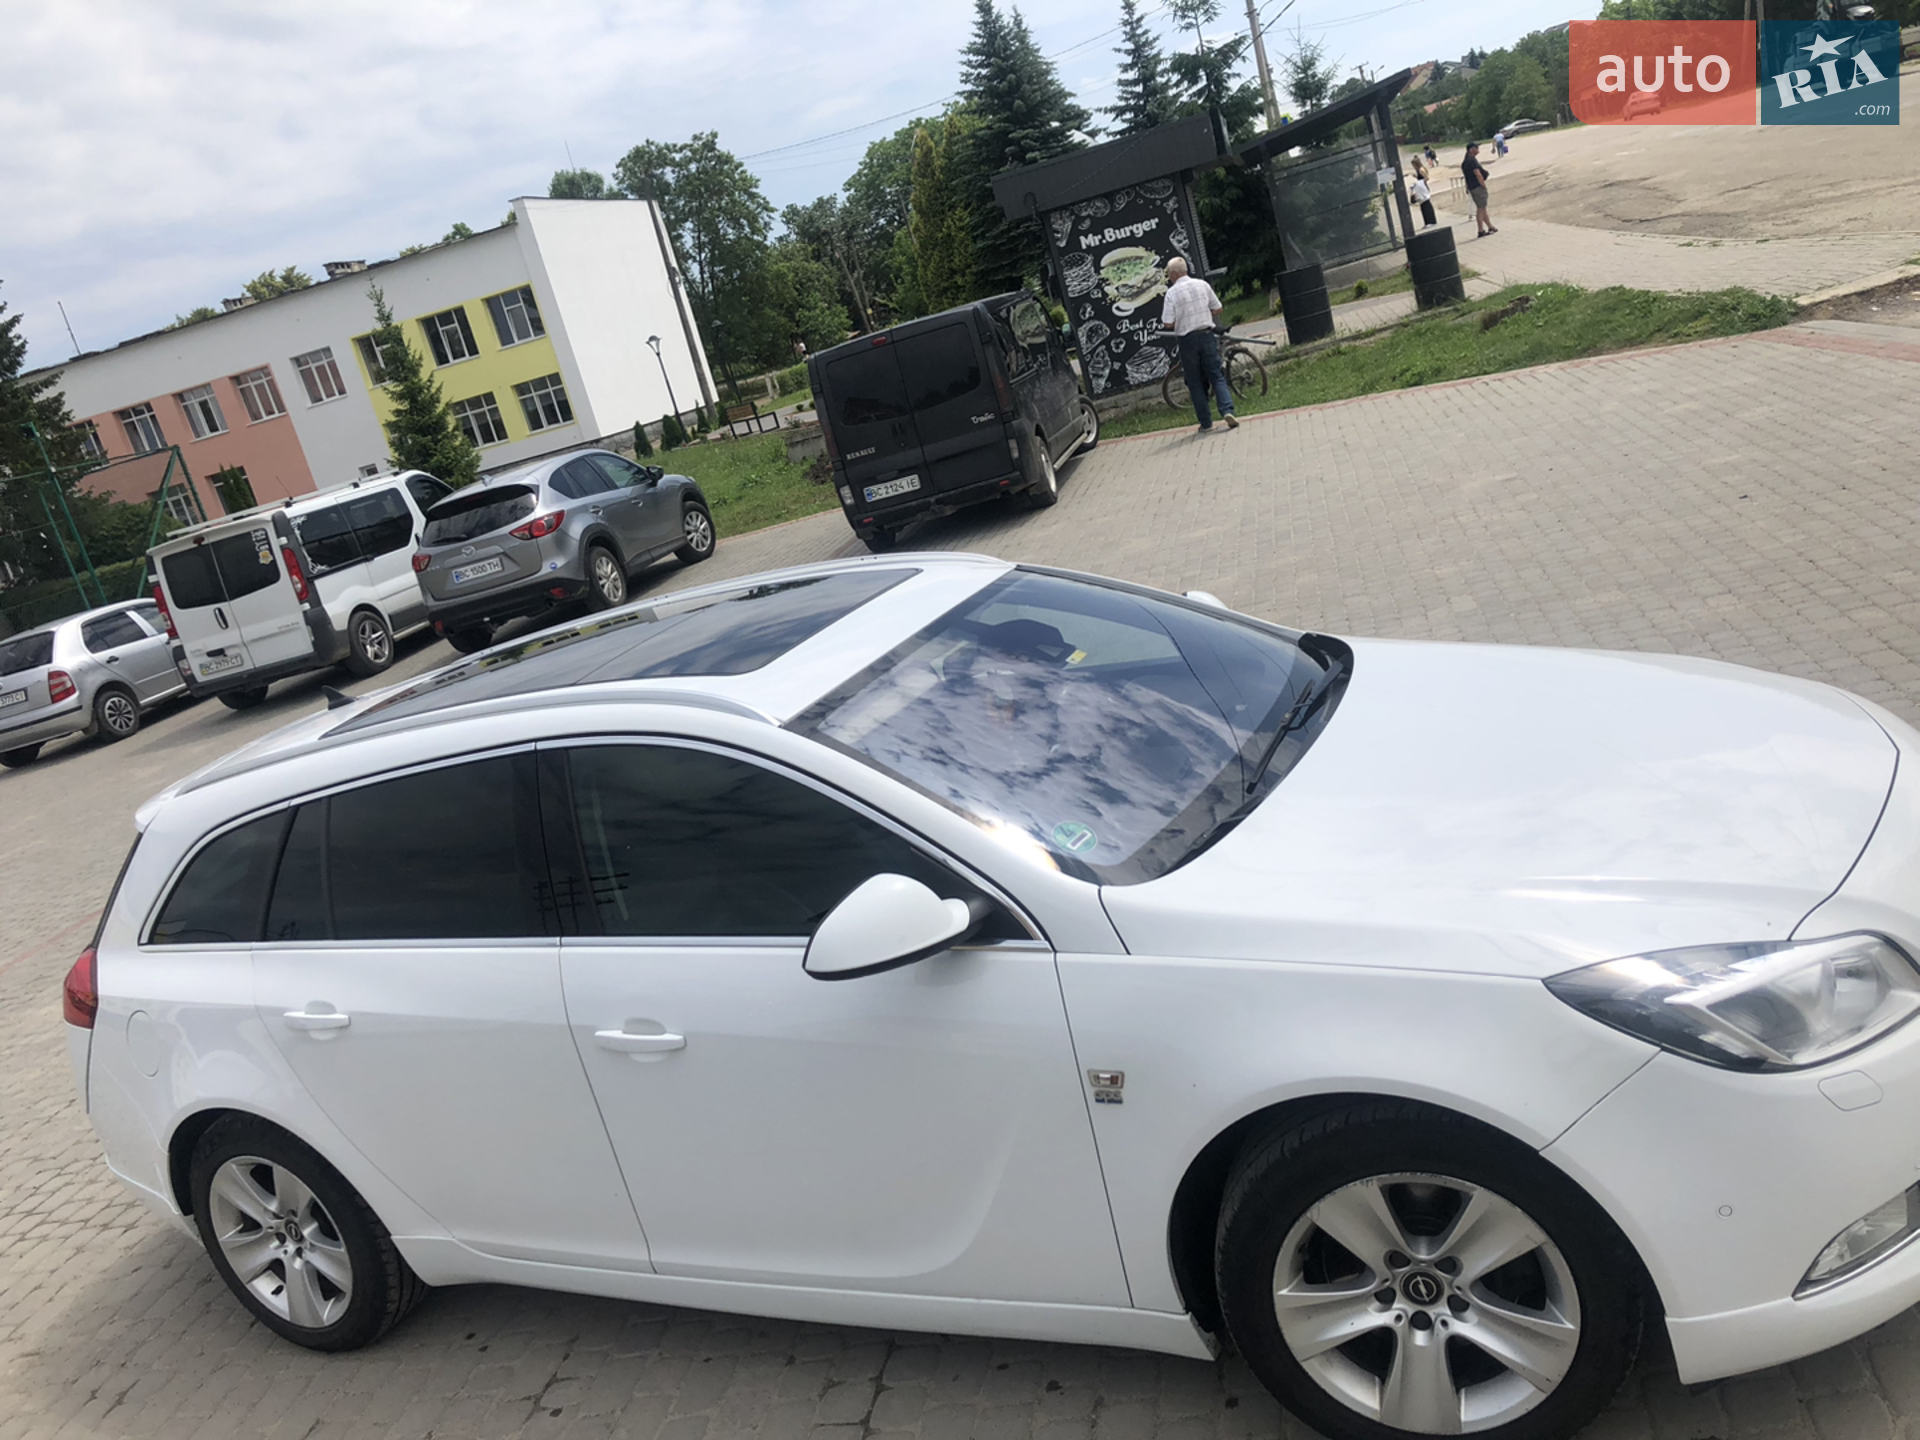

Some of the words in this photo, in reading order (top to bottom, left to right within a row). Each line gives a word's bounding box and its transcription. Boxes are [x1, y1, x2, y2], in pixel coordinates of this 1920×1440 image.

[1116, 318, 1143, 334] Best
[1146, 317, 1165, 333] Fo
[871, 486, 883, 498] BC
[884, 481, 905, 495] 2124
